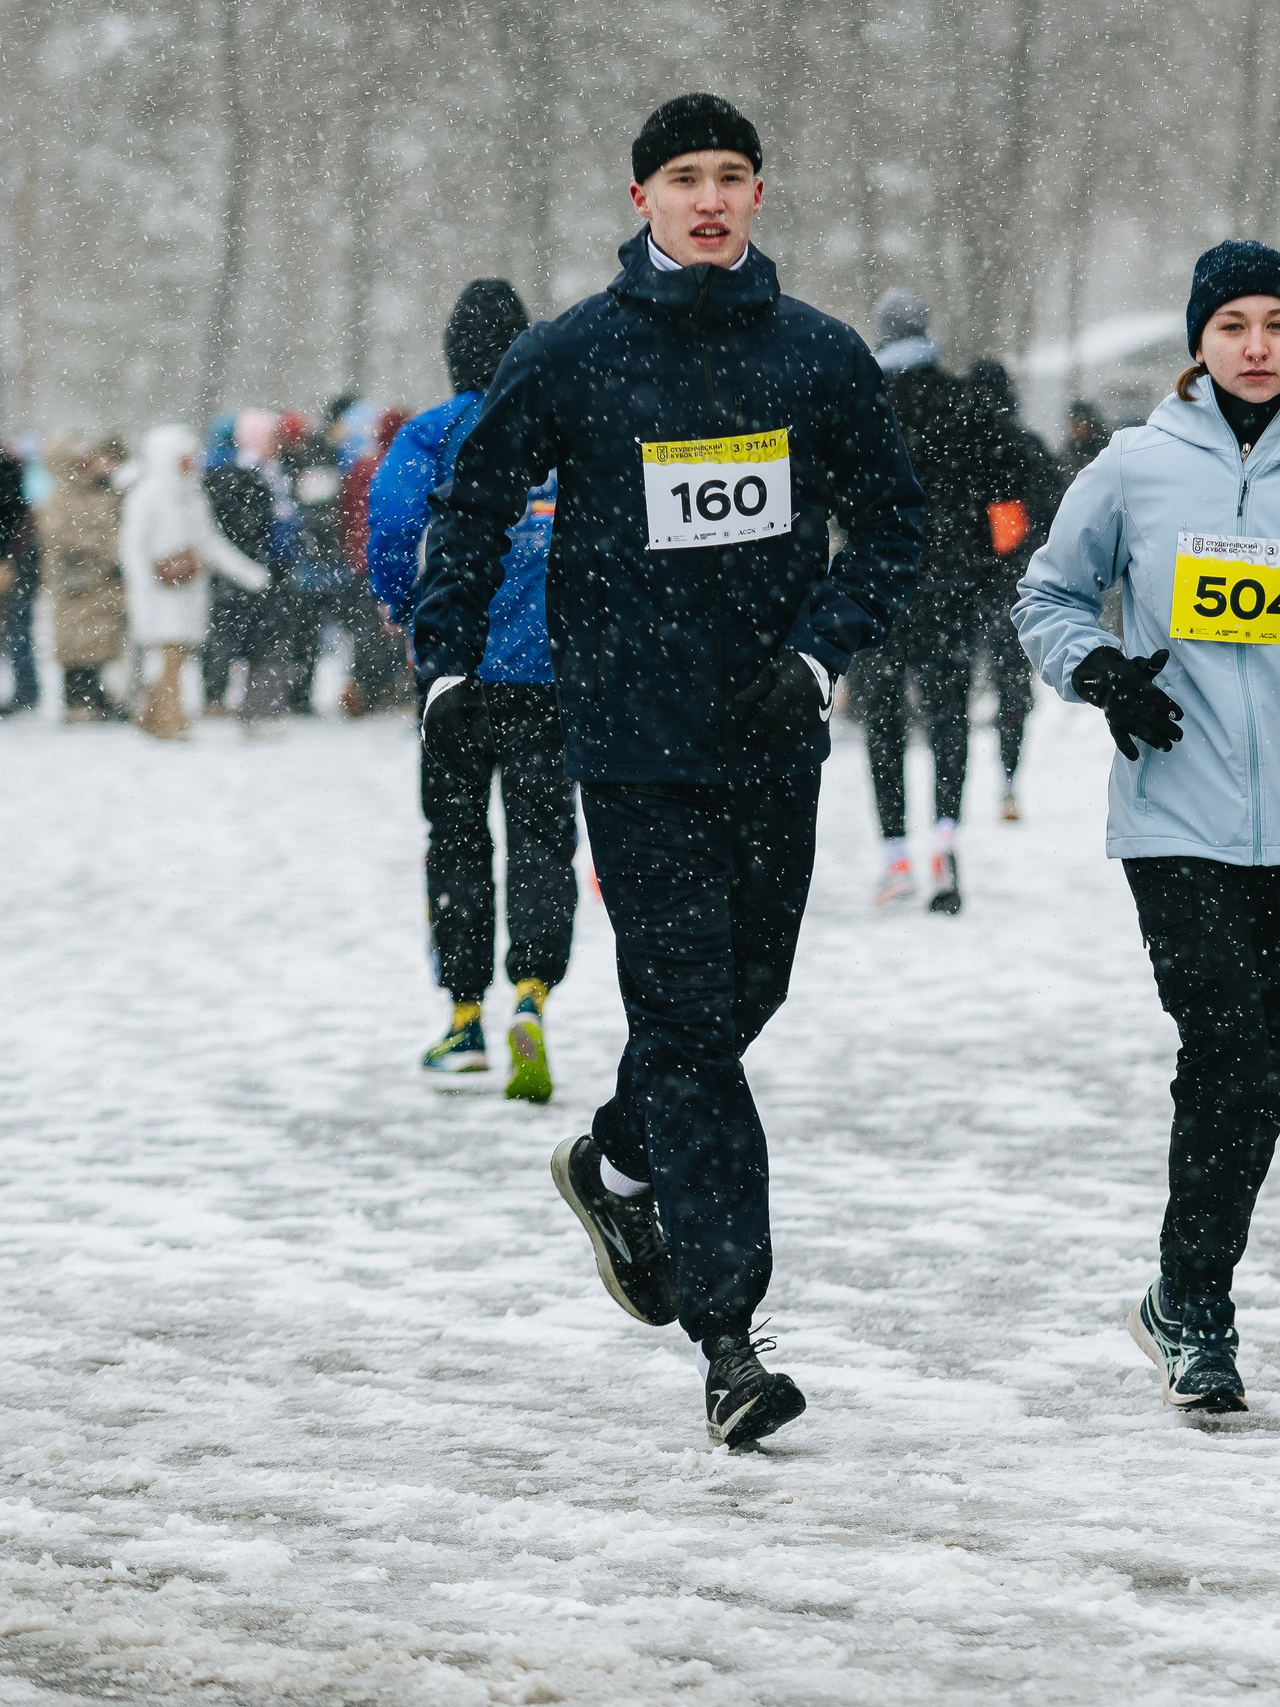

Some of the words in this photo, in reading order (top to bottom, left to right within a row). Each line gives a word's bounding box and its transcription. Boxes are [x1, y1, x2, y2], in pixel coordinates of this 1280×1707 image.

[670, 443, 723, 453] СТУДЕНЧЕСКИЙ
[733, 444, 740, 452] 3
[745, 438, 777, 451] ЭТАП
[670, 475, 767, 523] 160
[1205, 540, 1258, 550] СТУДЕНЧЕСКИЙ
[1267, 547, 1275, 556] 3
